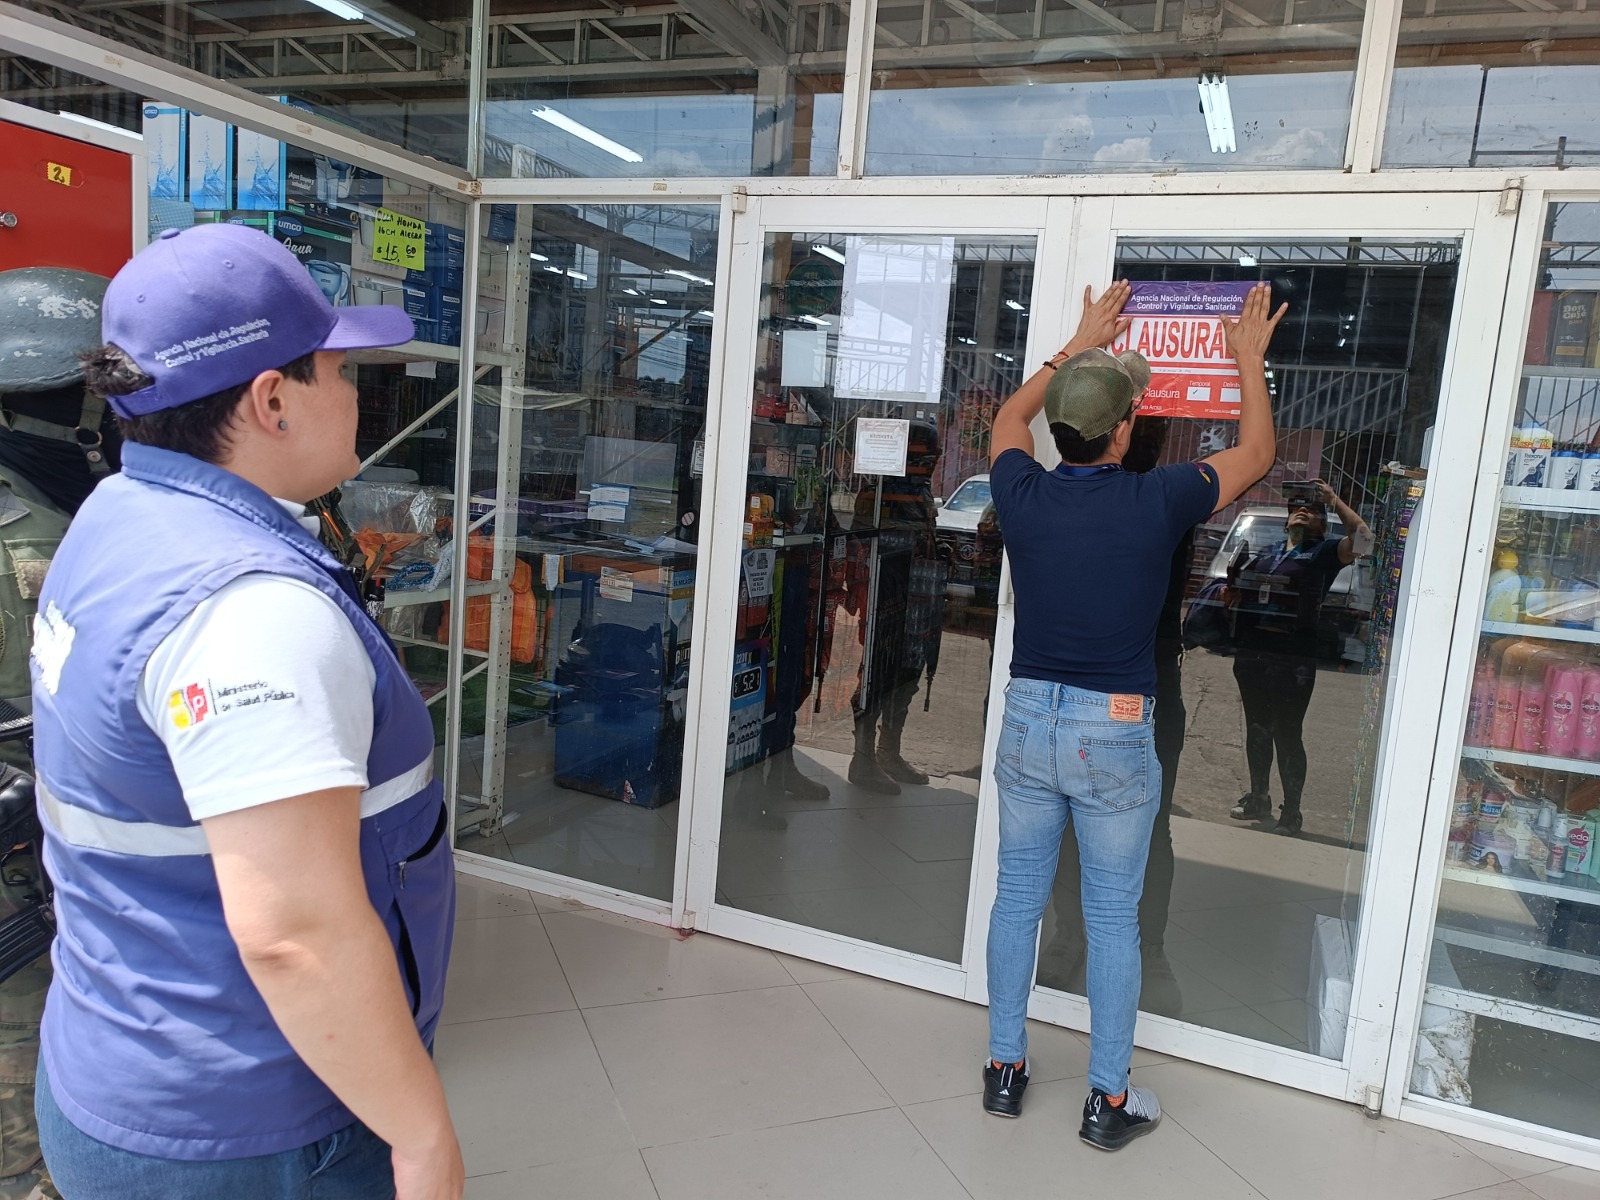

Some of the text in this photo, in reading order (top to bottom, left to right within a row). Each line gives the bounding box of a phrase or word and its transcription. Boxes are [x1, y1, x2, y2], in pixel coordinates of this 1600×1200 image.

[278, 220, 303, 233] umco
[1131, 294, 1159, 303] Agencia
[1202, 295, 1244, 304] Regulación,
[1137, 302, 1163, 310] Control
[1170, 303, 1203, 311] Vigilancia
[1204, 303, 1236, 311] Sanitaria
[1111, 319, 1236, 359] CLAUSURA
